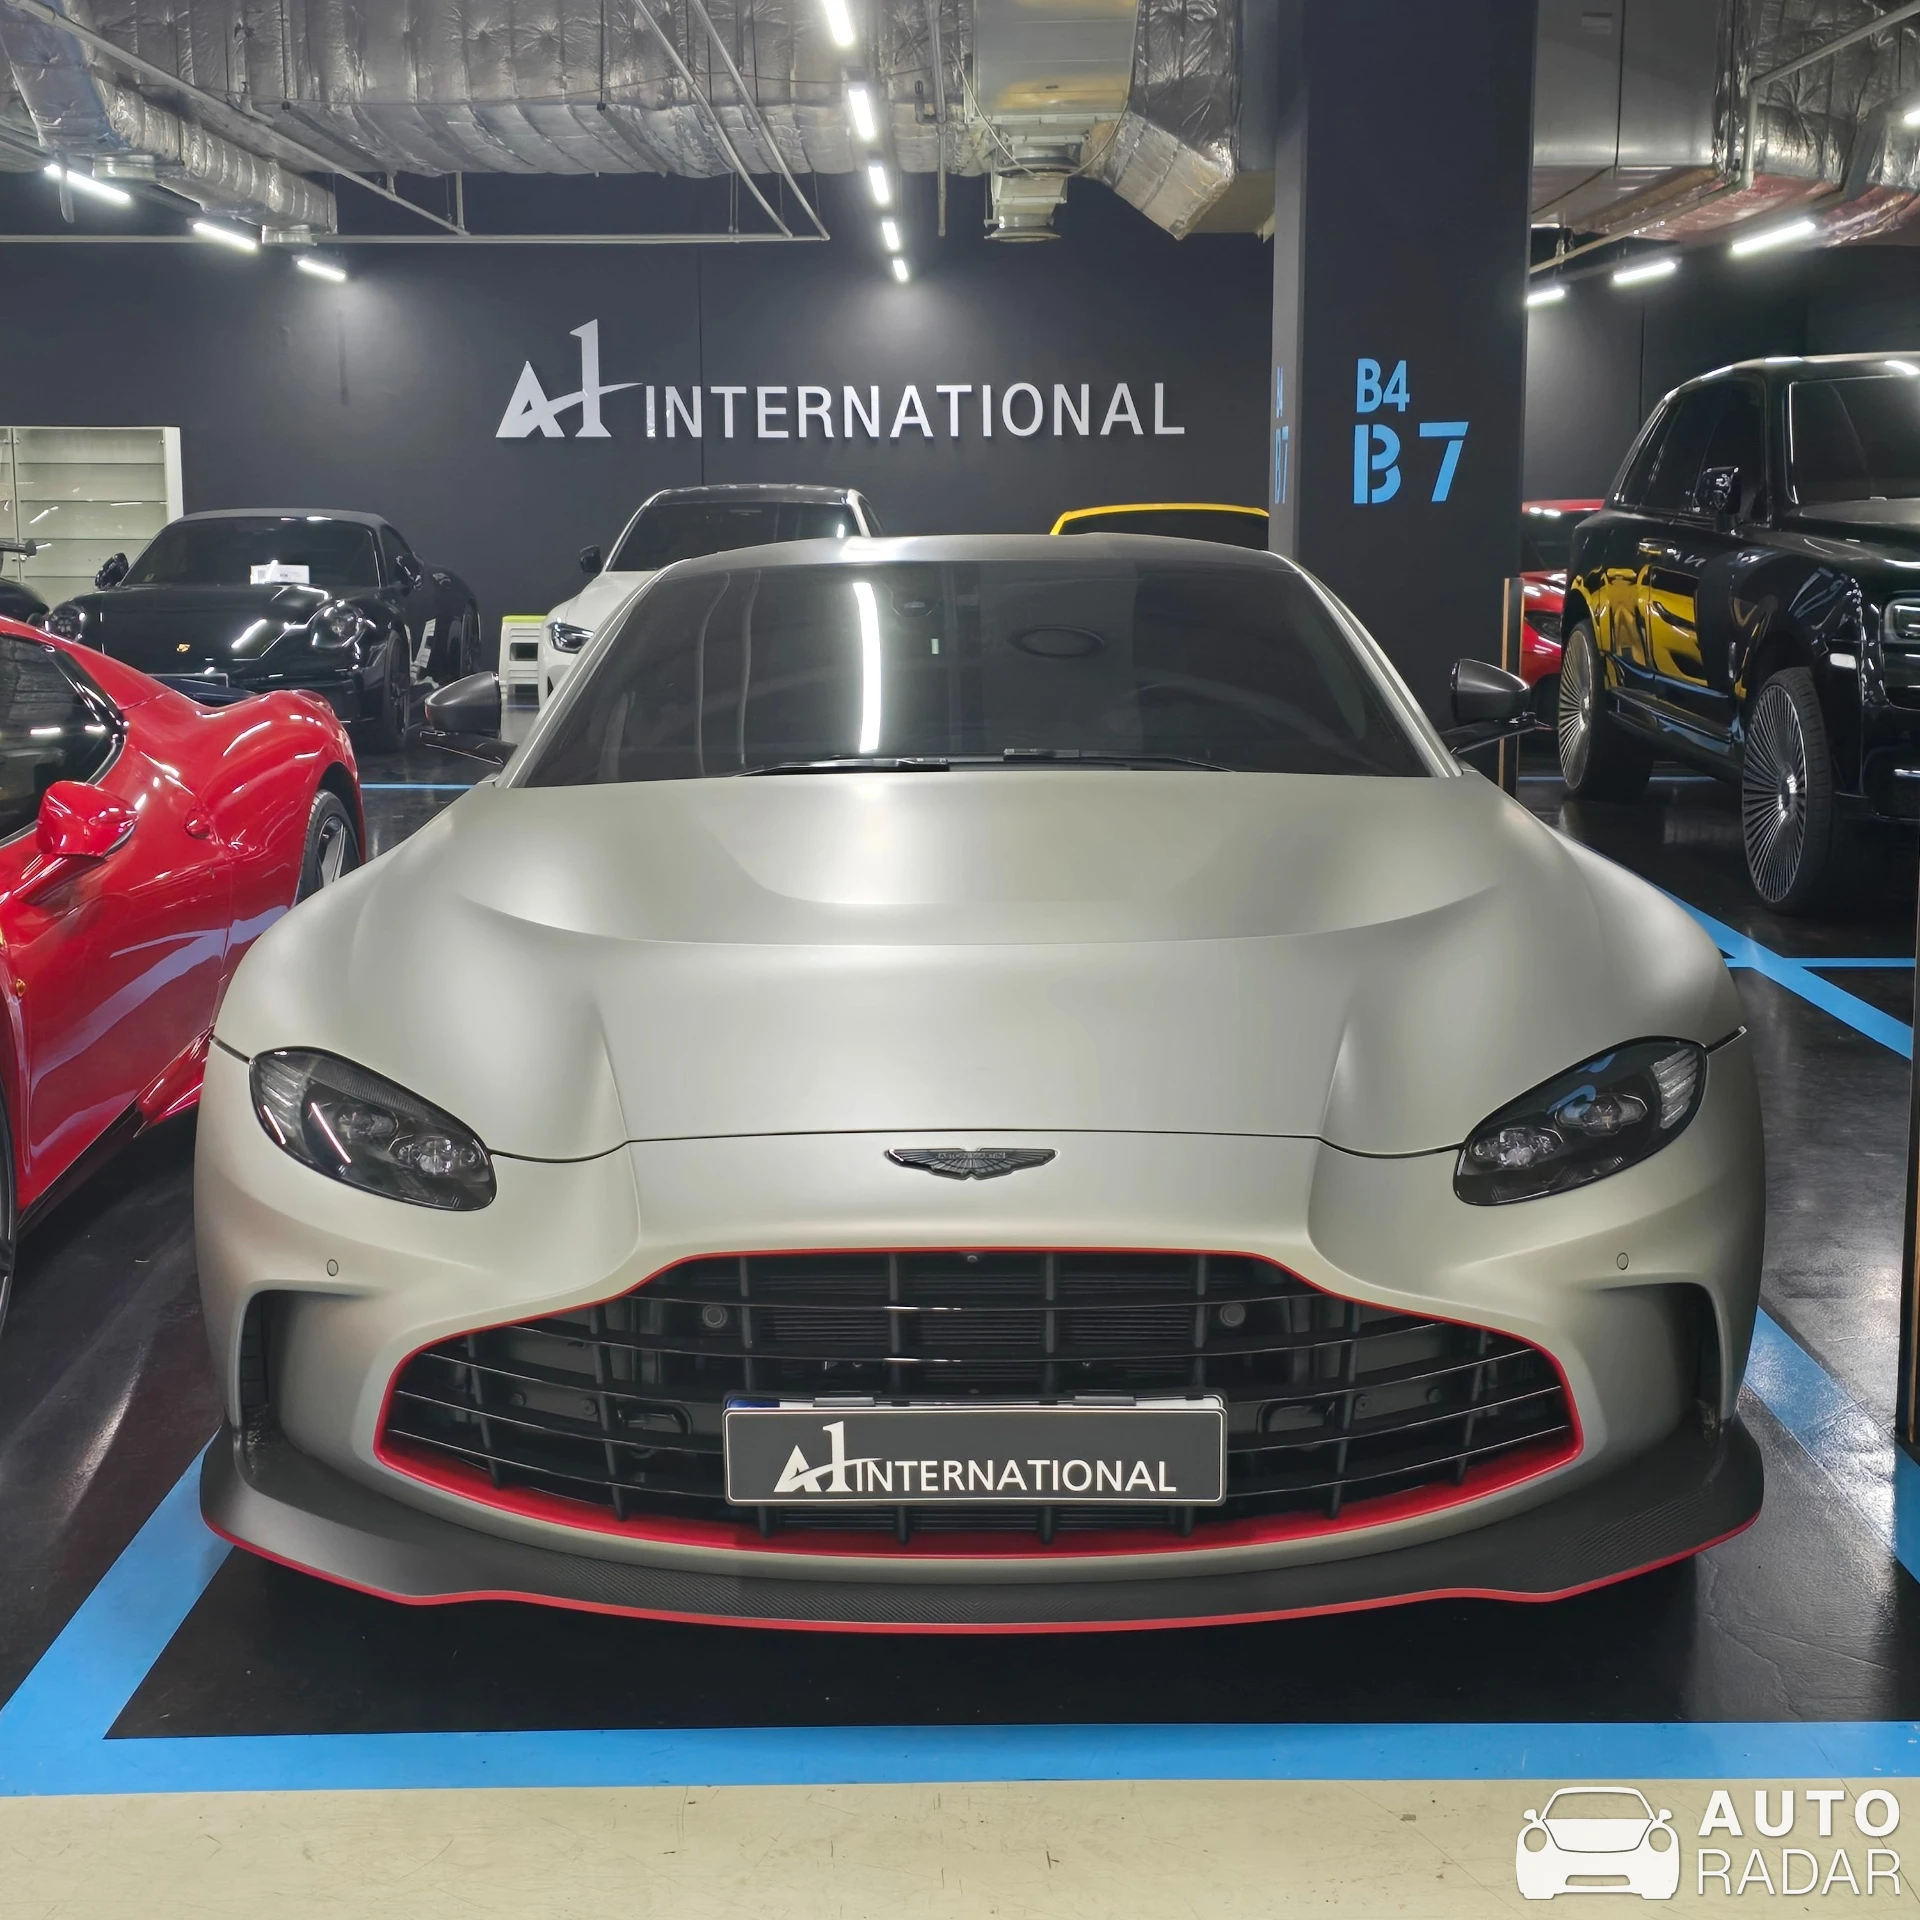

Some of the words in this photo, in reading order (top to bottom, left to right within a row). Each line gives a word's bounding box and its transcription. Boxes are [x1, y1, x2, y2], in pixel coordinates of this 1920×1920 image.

[646, 382, 1185, 438] INTERNATIONAL
[1356, 358, 1410, 413] B4
[857, 1460, 1177, 1492] INTERNATIONAL
